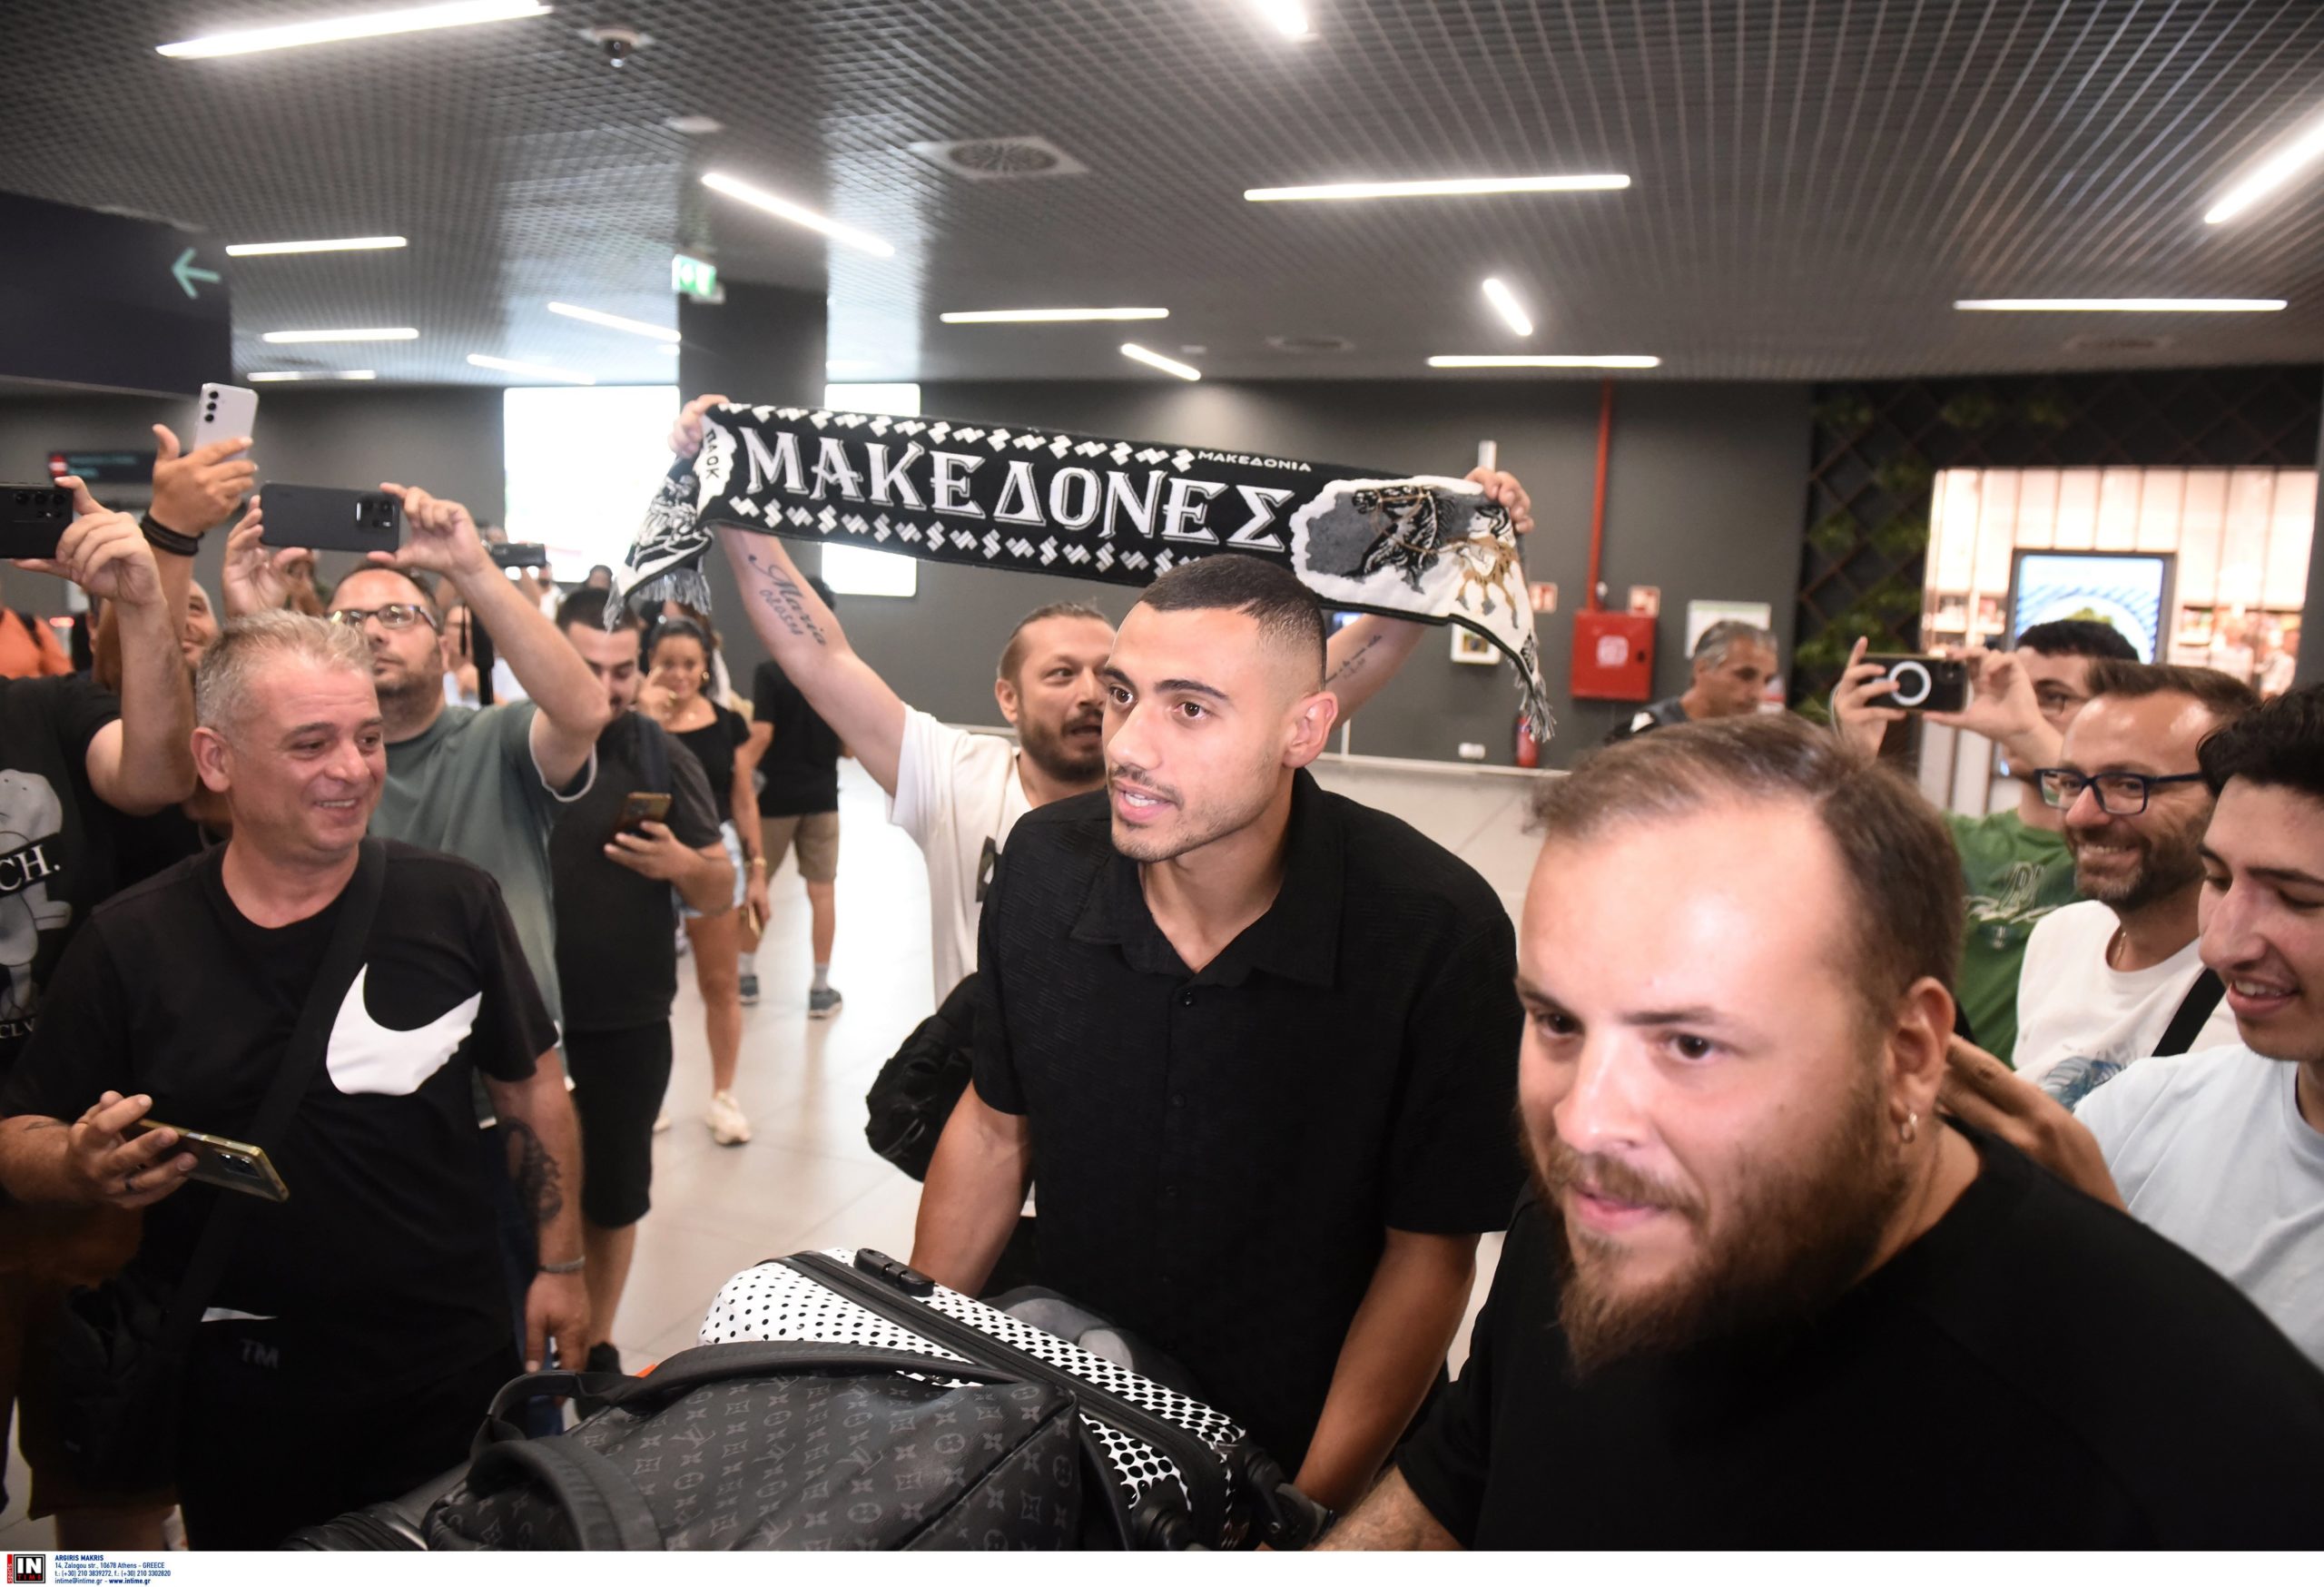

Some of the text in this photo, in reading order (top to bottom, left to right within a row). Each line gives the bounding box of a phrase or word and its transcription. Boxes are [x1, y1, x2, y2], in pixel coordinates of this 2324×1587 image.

[705, 429, 720, 479] ΠΑΟΚ
[1197, 450, 1313, 472] ΜΑΚΕΔΟΝΙΑ
[736, 426, 1295, 553] ΜΑΚΕΔΟΝΕΣ
[240, 1338, 280, 1369] TM
